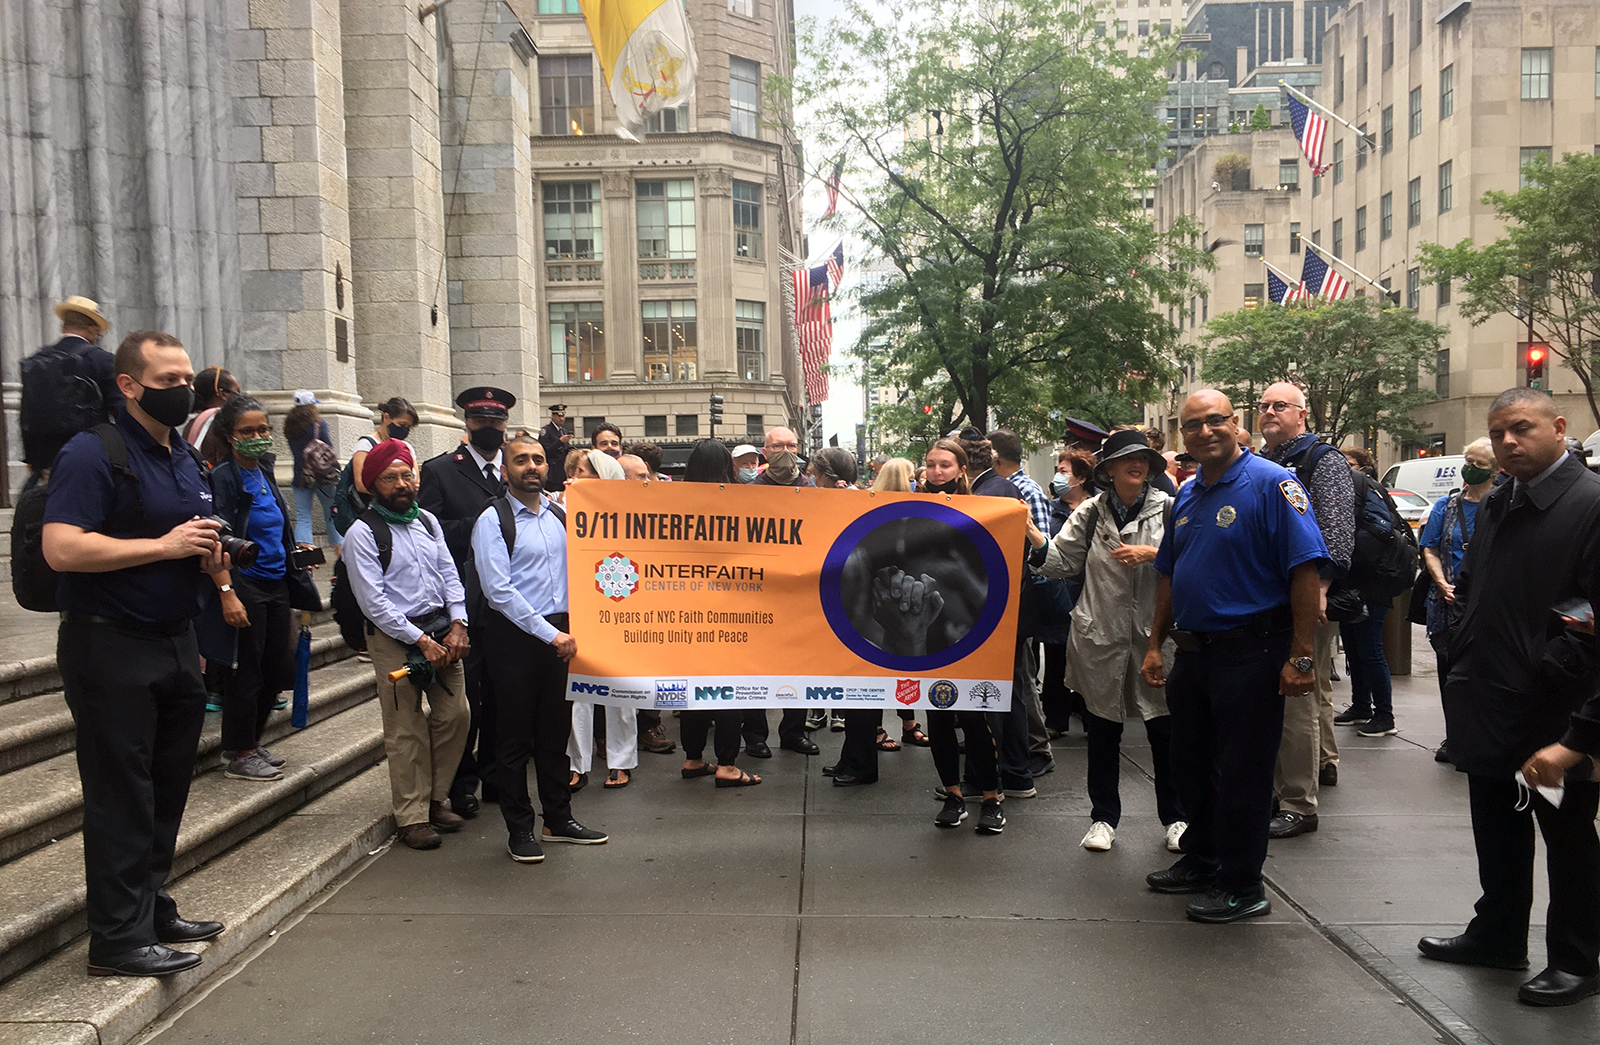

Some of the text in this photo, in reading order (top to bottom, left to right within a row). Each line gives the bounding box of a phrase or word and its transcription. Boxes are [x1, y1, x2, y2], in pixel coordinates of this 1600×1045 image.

[575, 512, 803, 546] 9/11 INTERFAITH WALK
[644, 564, 764, 581] INTERFAITH
[644, 581, 763, 592] CENTER OF NEW YORK
[599, 610, 774, 625] 20 years of NYC Faith Communities
[624, 629, 748, 644] Building Unity and Peace
[572, 682, 610, 696] NYC
[900, 681, 910, 689] THE
[656, 692, 686, 700] NYDIS
[695, 686, 734, 700] NYC
[806, 687, 844, 700] NYC
[904, 690, 917, 702] ARMY
